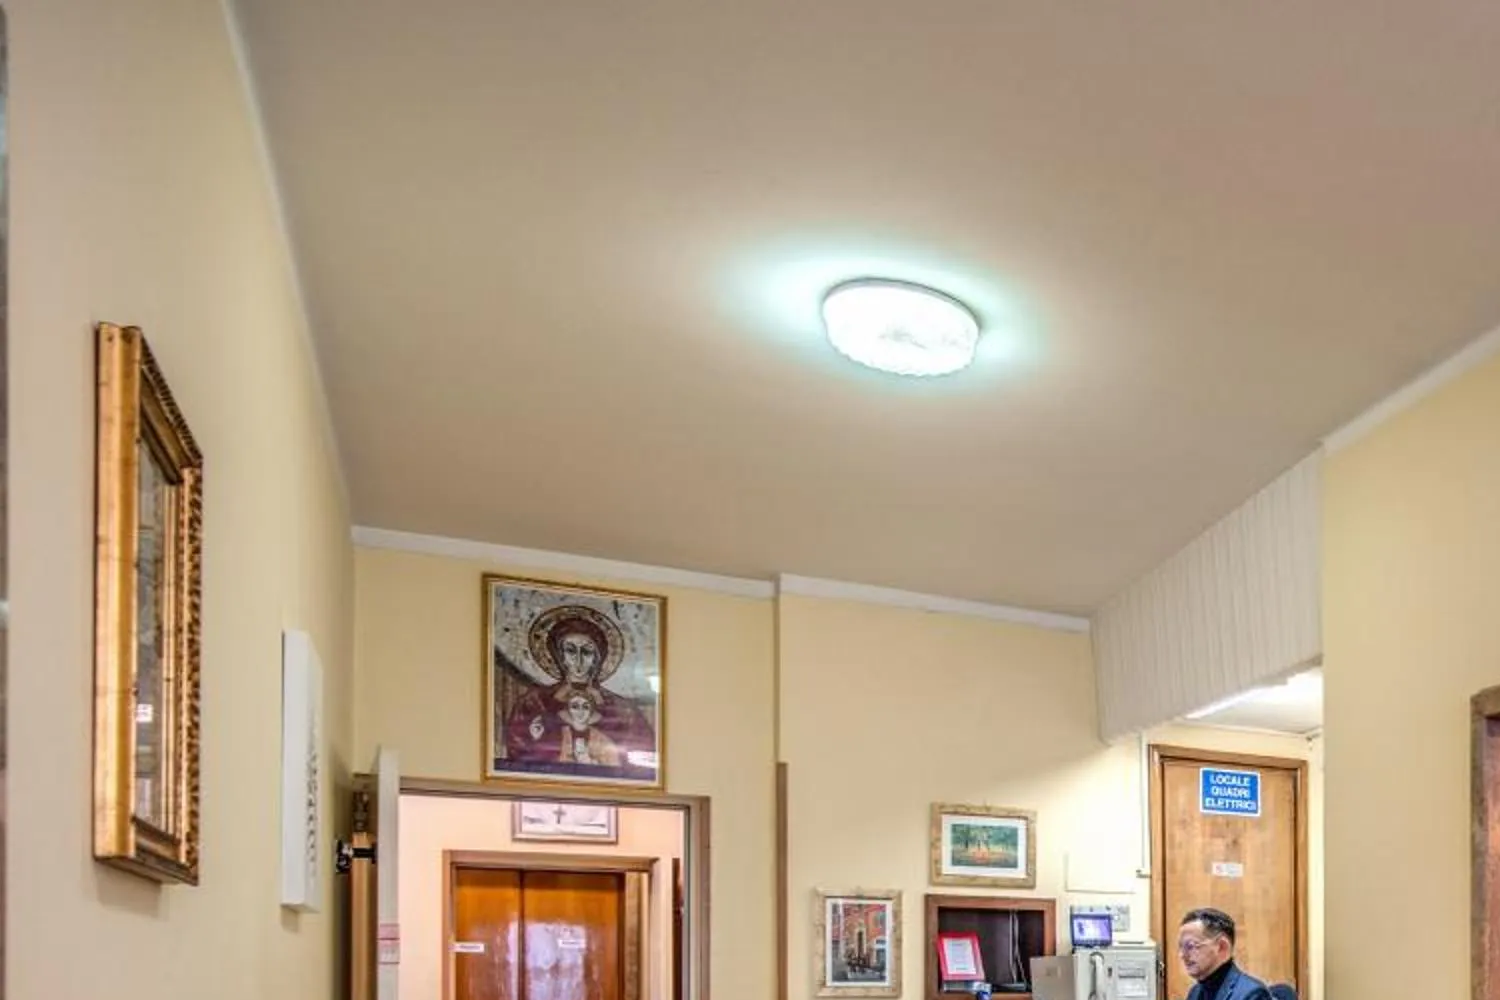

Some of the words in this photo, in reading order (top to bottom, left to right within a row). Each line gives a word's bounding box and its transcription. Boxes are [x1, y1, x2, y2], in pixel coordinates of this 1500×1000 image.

[1209, 774, 1250, 786] LOCALE
[1211, 786, 1250, 798] QUADRI
[1205, 798, 1256, 810] ELETTRICI
